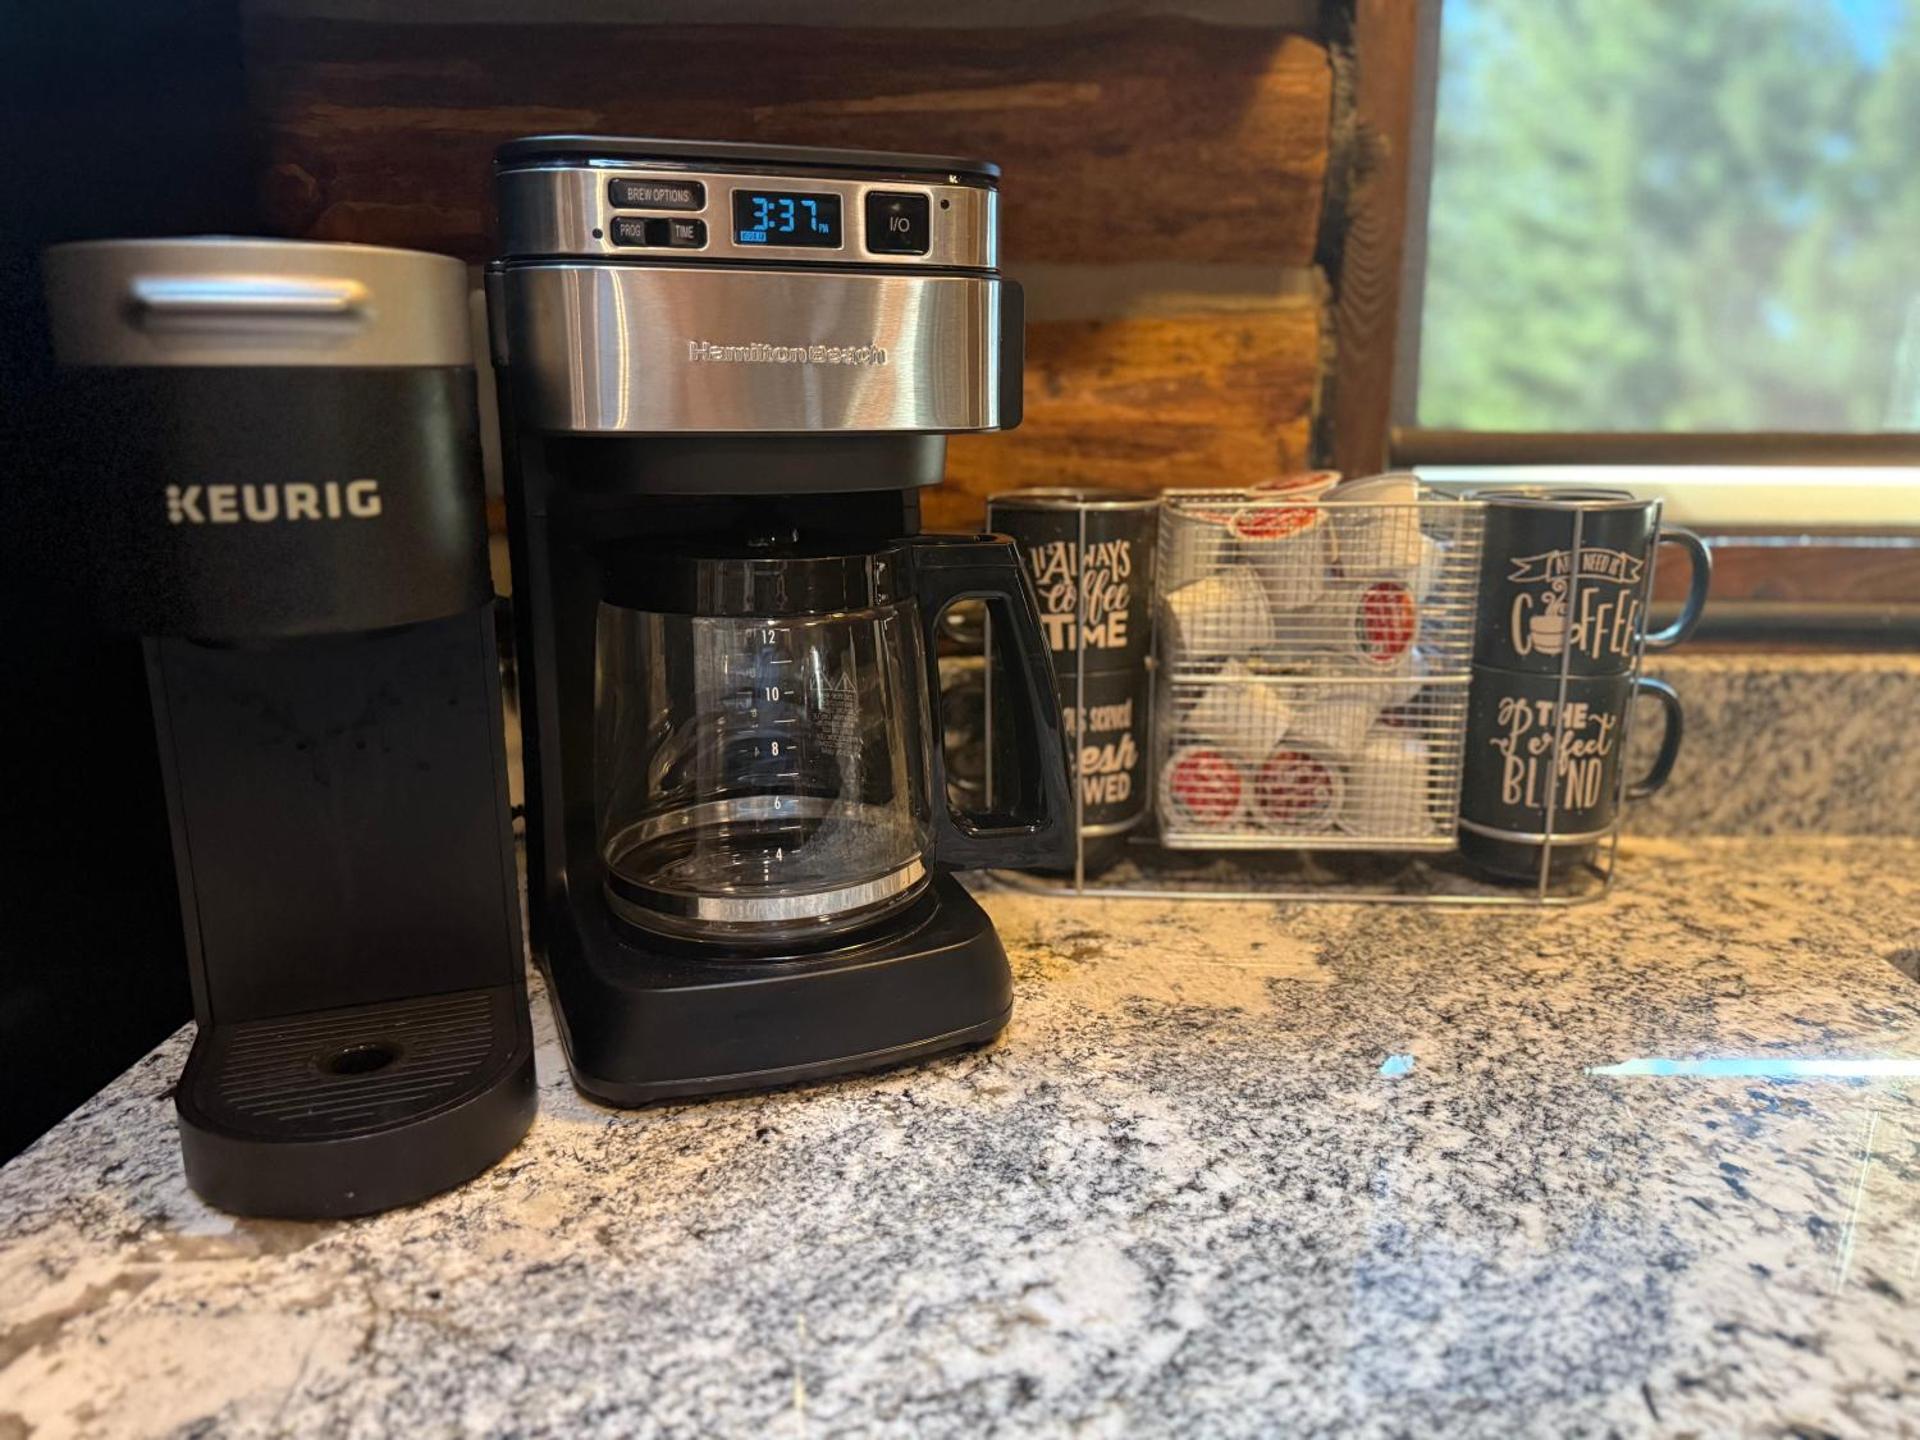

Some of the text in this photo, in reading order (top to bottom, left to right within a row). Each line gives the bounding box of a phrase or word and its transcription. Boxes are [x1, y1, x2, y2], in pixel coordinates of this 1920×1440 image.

[627, 187, 690, 203] BREW OPTIONS
[752, 197, 817, 232] 3:37
[620, 223, 641, 237] PROG
[889, 216, 910, 232] I/O
[675, 225, 694, 239] TIME
[688, 340, 888, 366] Hamilton Beach
[165, 479, 383, 525] KEURIG
[761, 630, 776, 645] 12
[1040, 610, 1129, 651] TIME
[765, 687, 779, 701] 10
[1535, 700, 1589, 730] THE
[771, 742, 779, 756] 8
[774, 798, 781, 810] 6
[775, 848, 783, 862] 4
